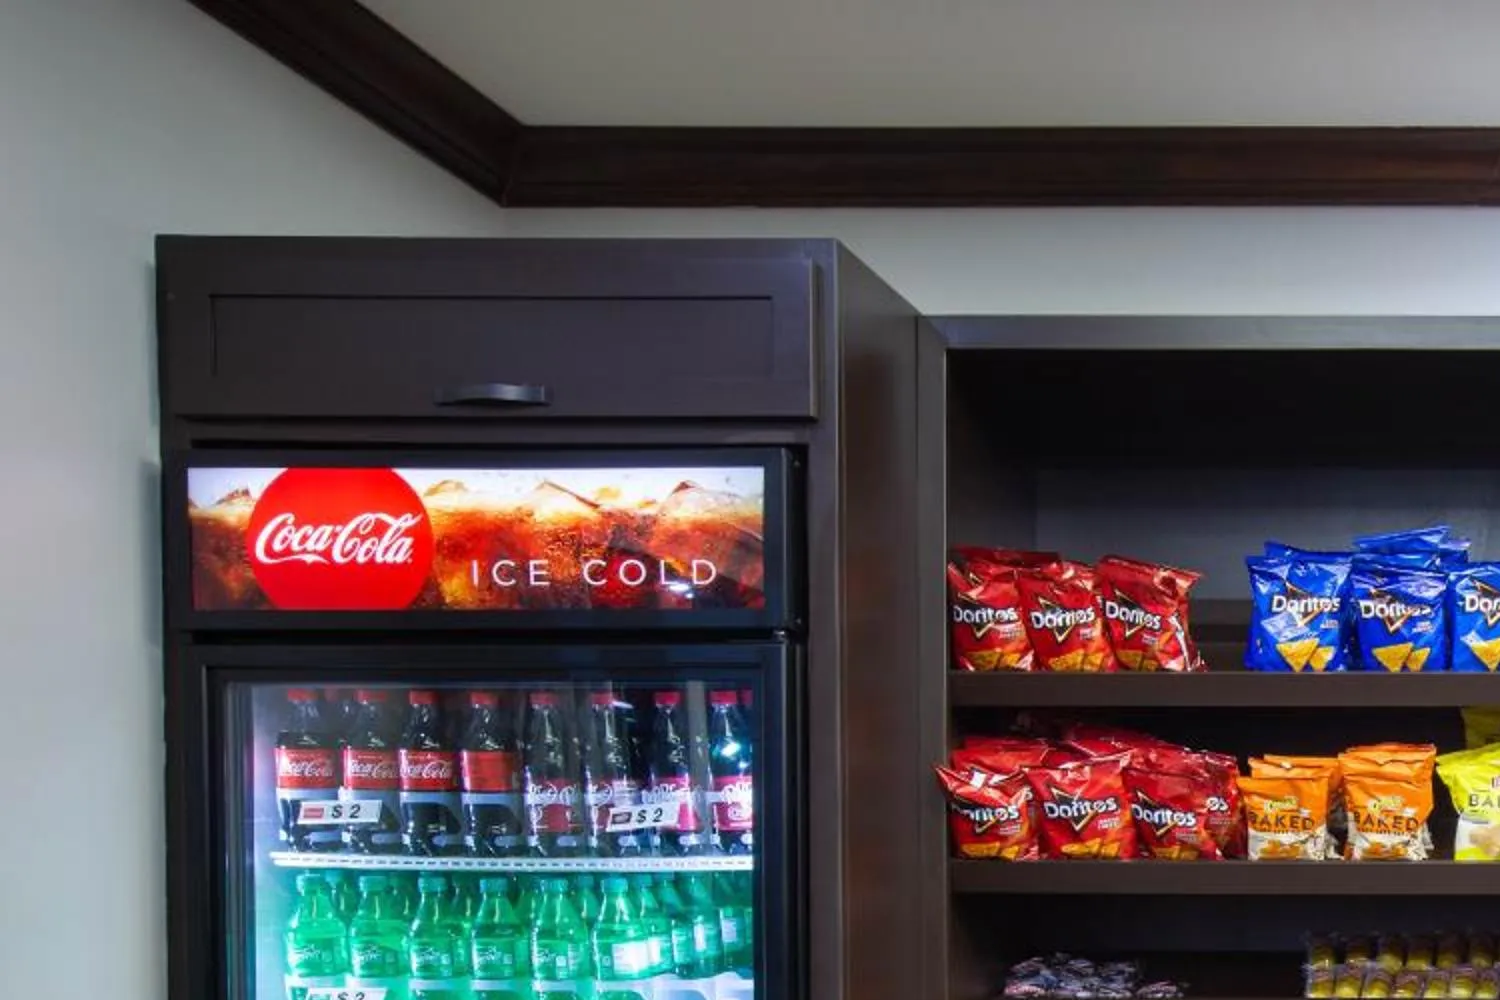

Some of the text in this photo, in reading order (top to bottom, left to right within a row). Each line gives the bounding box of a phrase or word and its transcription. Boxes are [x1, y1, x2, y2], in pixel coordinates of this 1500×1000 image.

[254, 511, 421, 566] Coca-Cola
[472, 558, 719, 587] ICE COLD
[953, 606, 1019, 624] Doritos
[1104, 600, 1162, 630] Doritos
[1271, 595, 1342, 613] Doritos
[1031, 606, 1096, 629] Doritos
[1044, 797, 1117, 819] Doritos
[1131, 803, 1196, 826] Doritos
[1248, 811, 1316, 831] BAKED
[1354, 811, 1419, 831] BAKED
